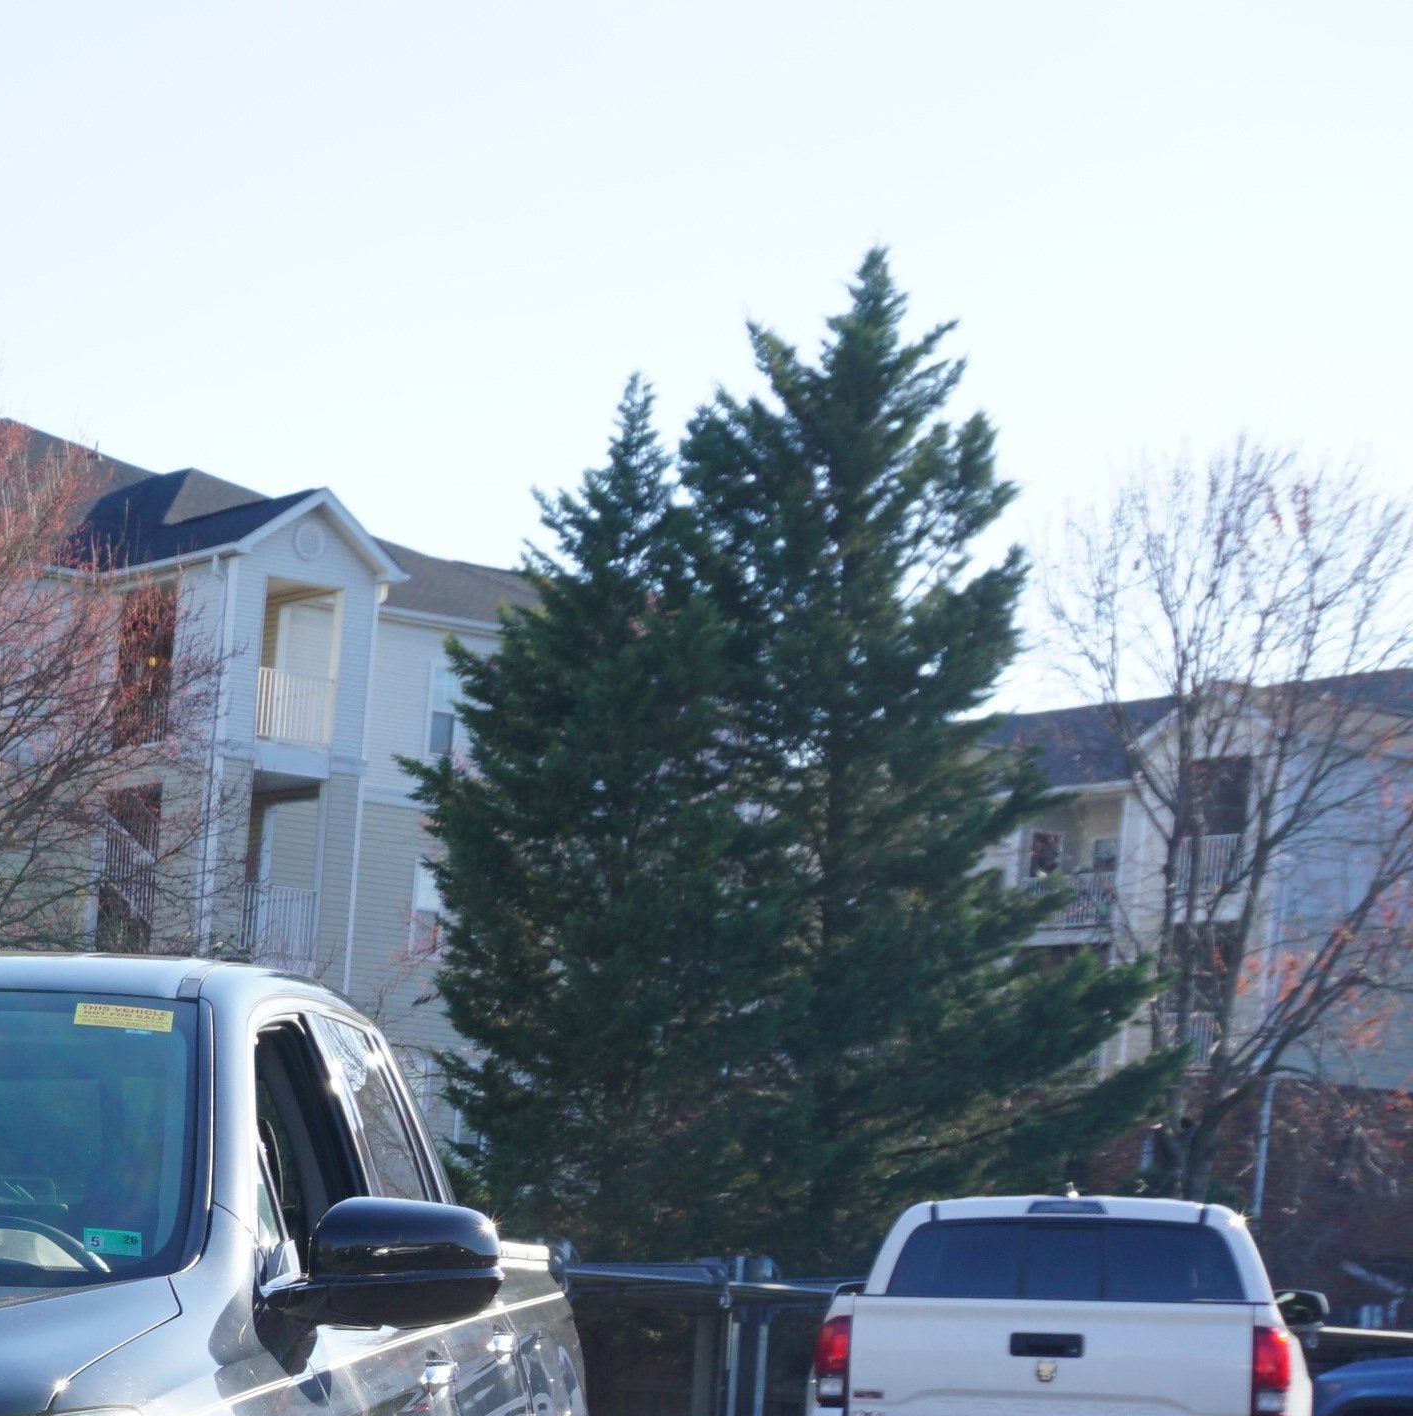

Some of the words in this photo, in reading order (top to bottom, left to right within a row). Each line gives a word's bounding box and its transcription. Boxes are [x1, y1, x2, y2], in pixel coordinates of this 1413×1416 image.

[114, 1007, 168, 1017] VEHICLE
[91, 1236, 100, 1247] 5
[123, 1235, 139, 1244] 26
